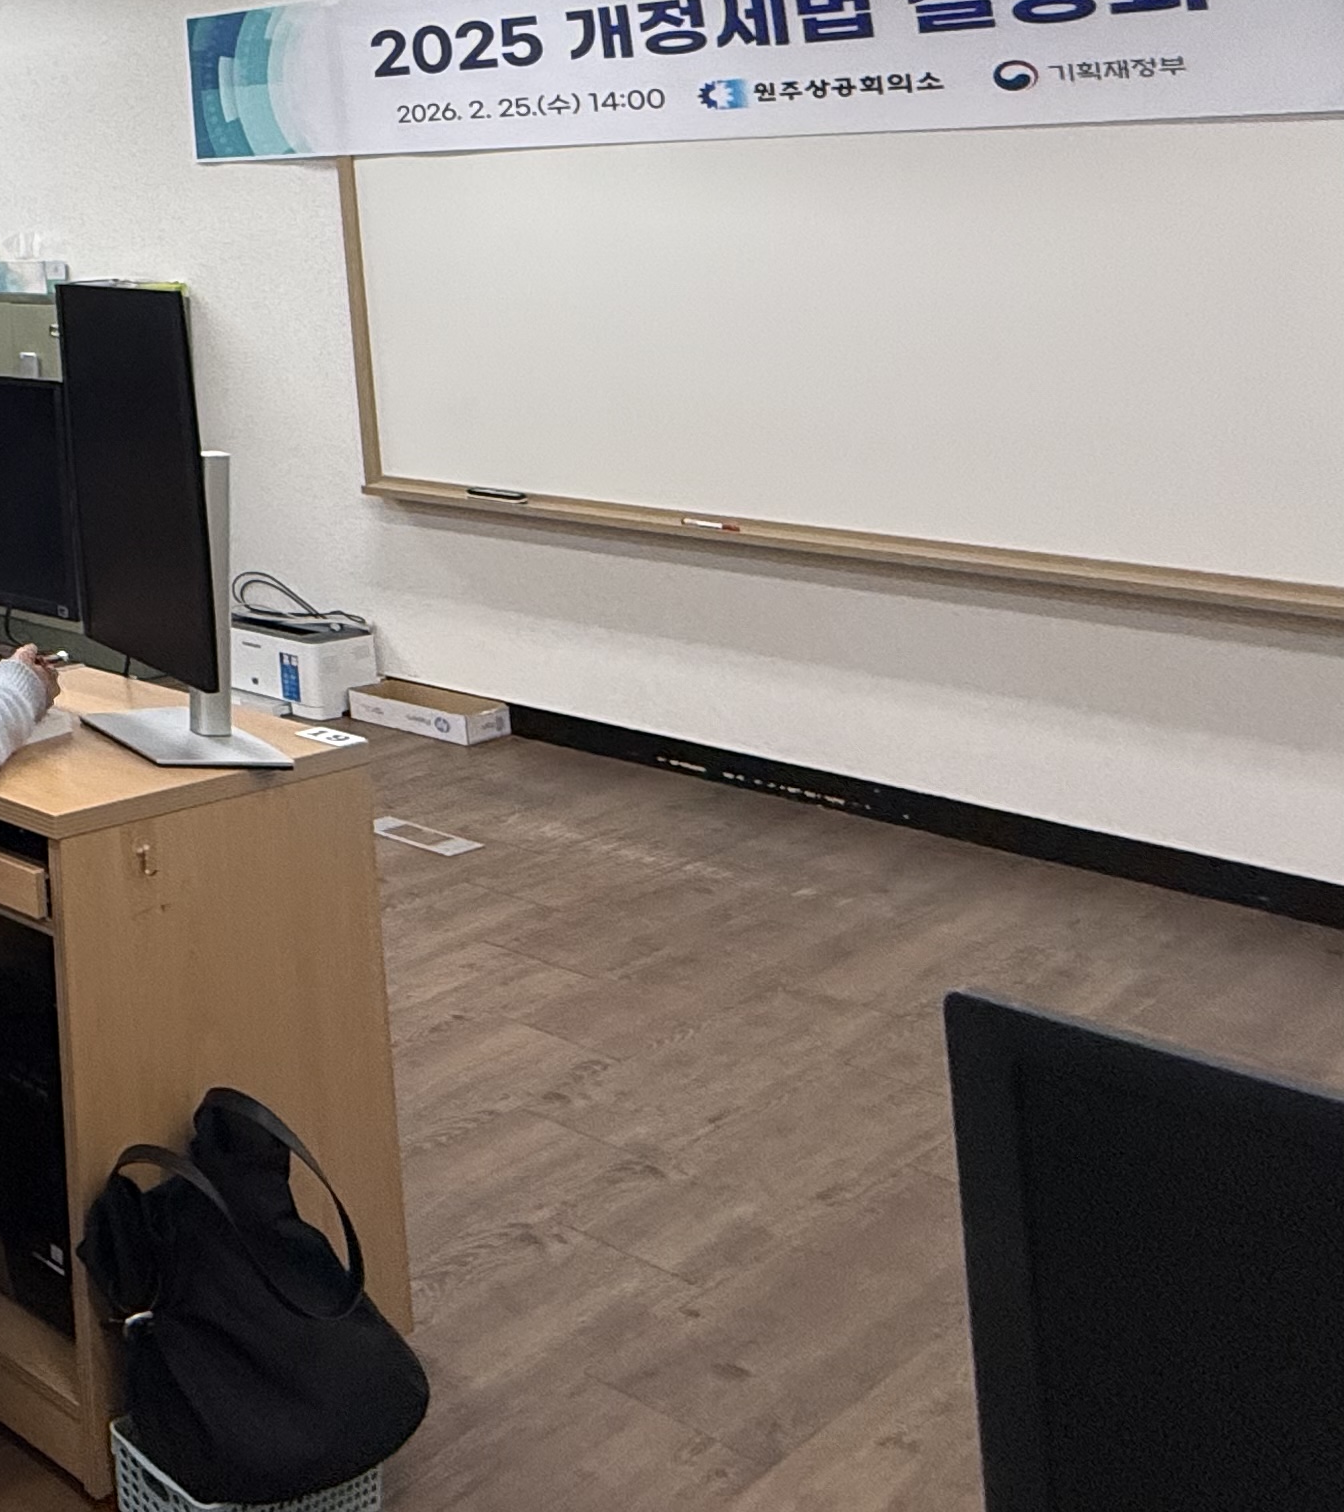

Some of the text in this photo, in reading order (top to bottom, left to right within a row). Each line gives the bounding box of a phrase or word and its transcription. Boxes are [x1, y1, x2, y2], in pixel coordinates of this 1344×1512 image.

[370, 15, 544, 78] 2025
[1047, 55, 1188, 83] 기획재정부
[753, 71, 945, 102] 원주상공회의소
[397, 88, 665, 124] 2026. 2. 25.(수) 14:00
[307, 729, 351, 742] 19
